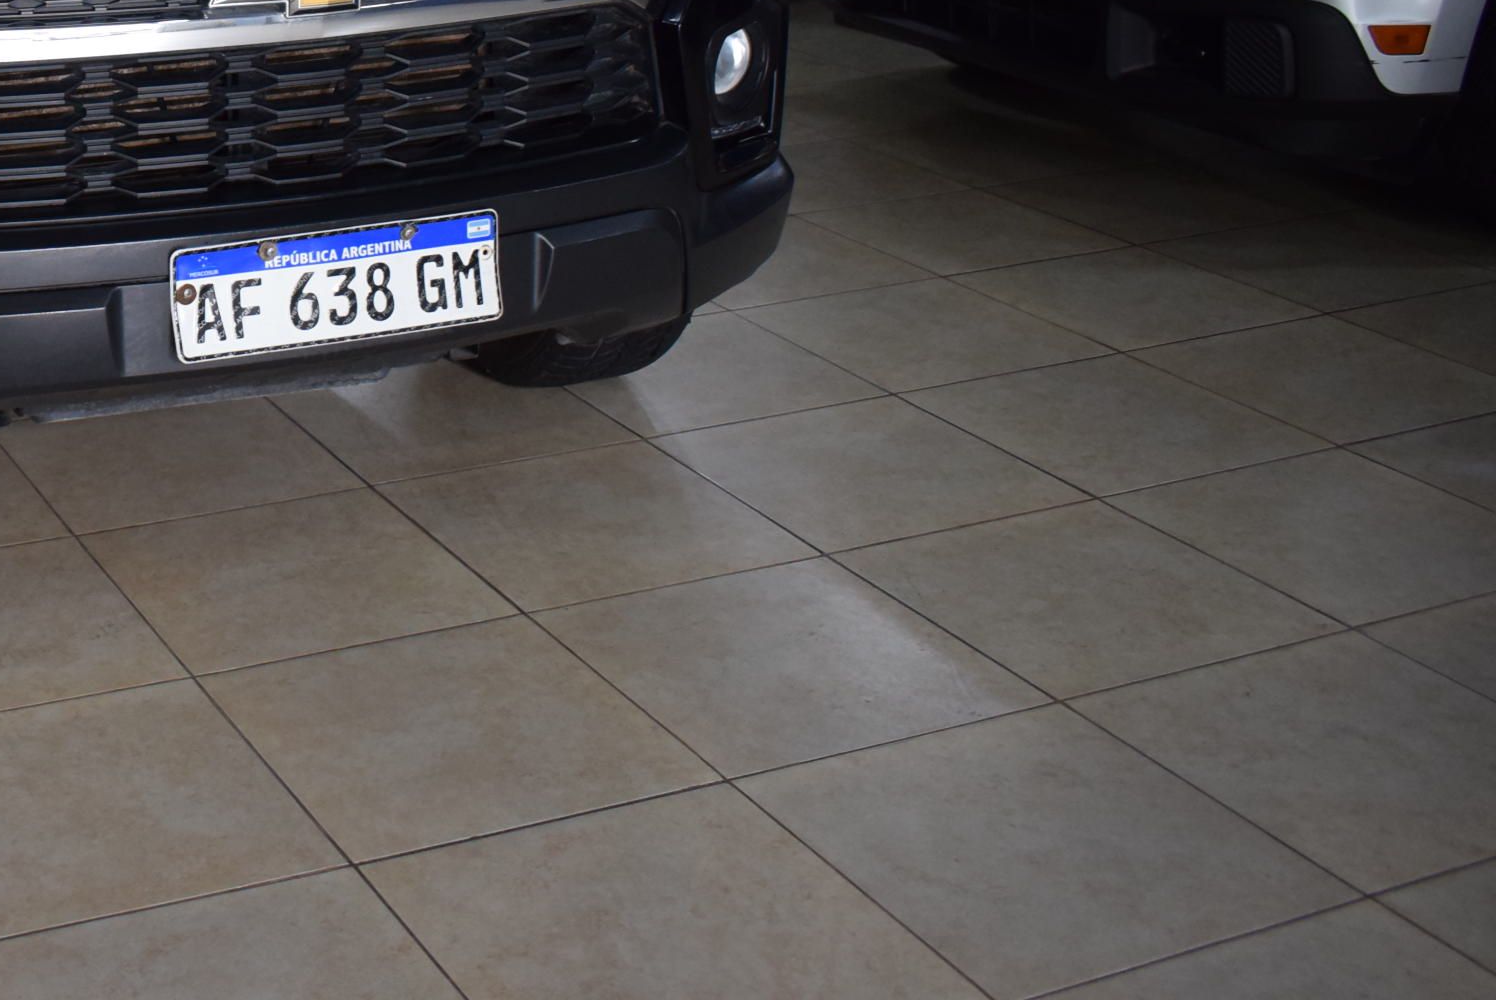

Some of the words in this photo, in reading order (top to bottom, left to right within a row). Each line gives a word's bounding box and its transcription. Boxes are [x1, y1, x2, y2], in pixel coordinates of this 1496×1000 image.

[265, 249, 339, 268] REPÚBLICA
[342, 239, 413, 260] ARGENTINA
[195, 278, 262, 344] AF
[289, 262, 395, 331] 638
[416, 249, 486, 314] GM
